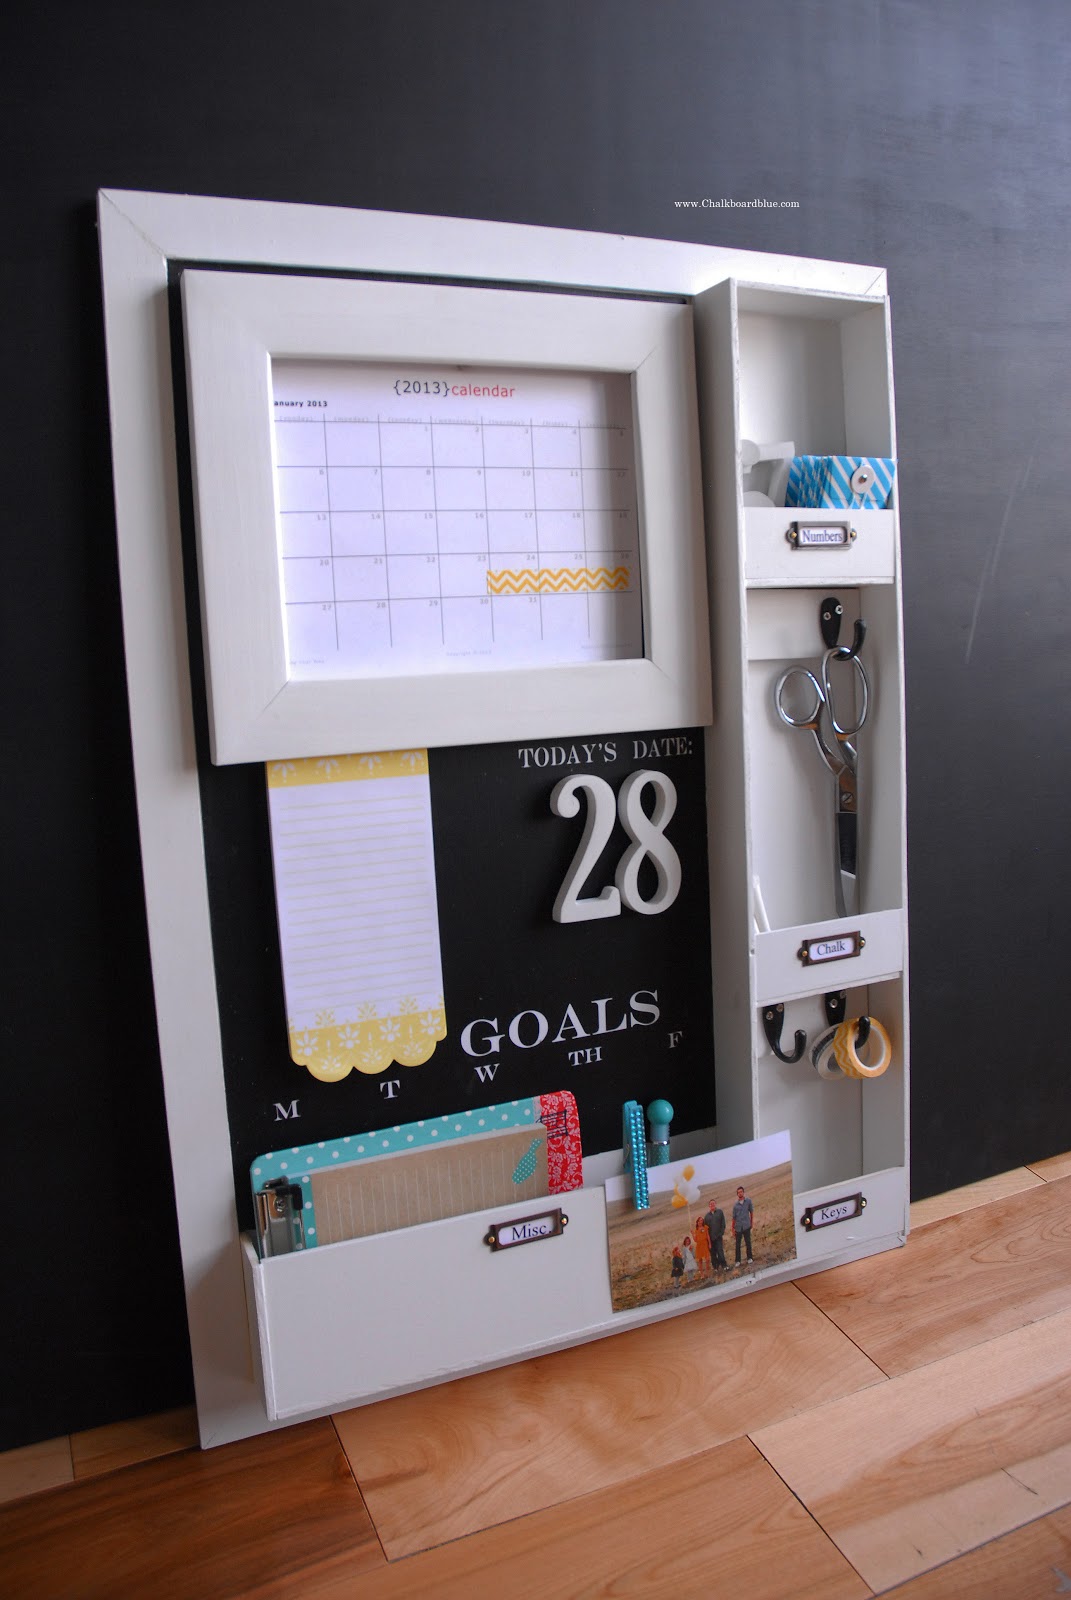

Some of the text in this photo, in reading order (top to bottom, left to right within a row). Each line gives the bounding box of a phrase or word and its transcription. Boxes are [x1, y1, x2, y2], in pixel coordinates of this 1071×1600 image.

[274, 400, 328, 408] anuary 2013
[802, 529, 843, 543] Numbers
[518, 737, 693, 769] TODAY'S DATE:
[549, 768, 682, 924] 28
[816, 940, 847, 956] Chalk
[460, 989, 661, 1057] GOALS
[273, 1031, 684, 1122] M T W TH F
[820, 1205, 849, 1220] Keys
[511, 1223, 553, 1241] Misc.
